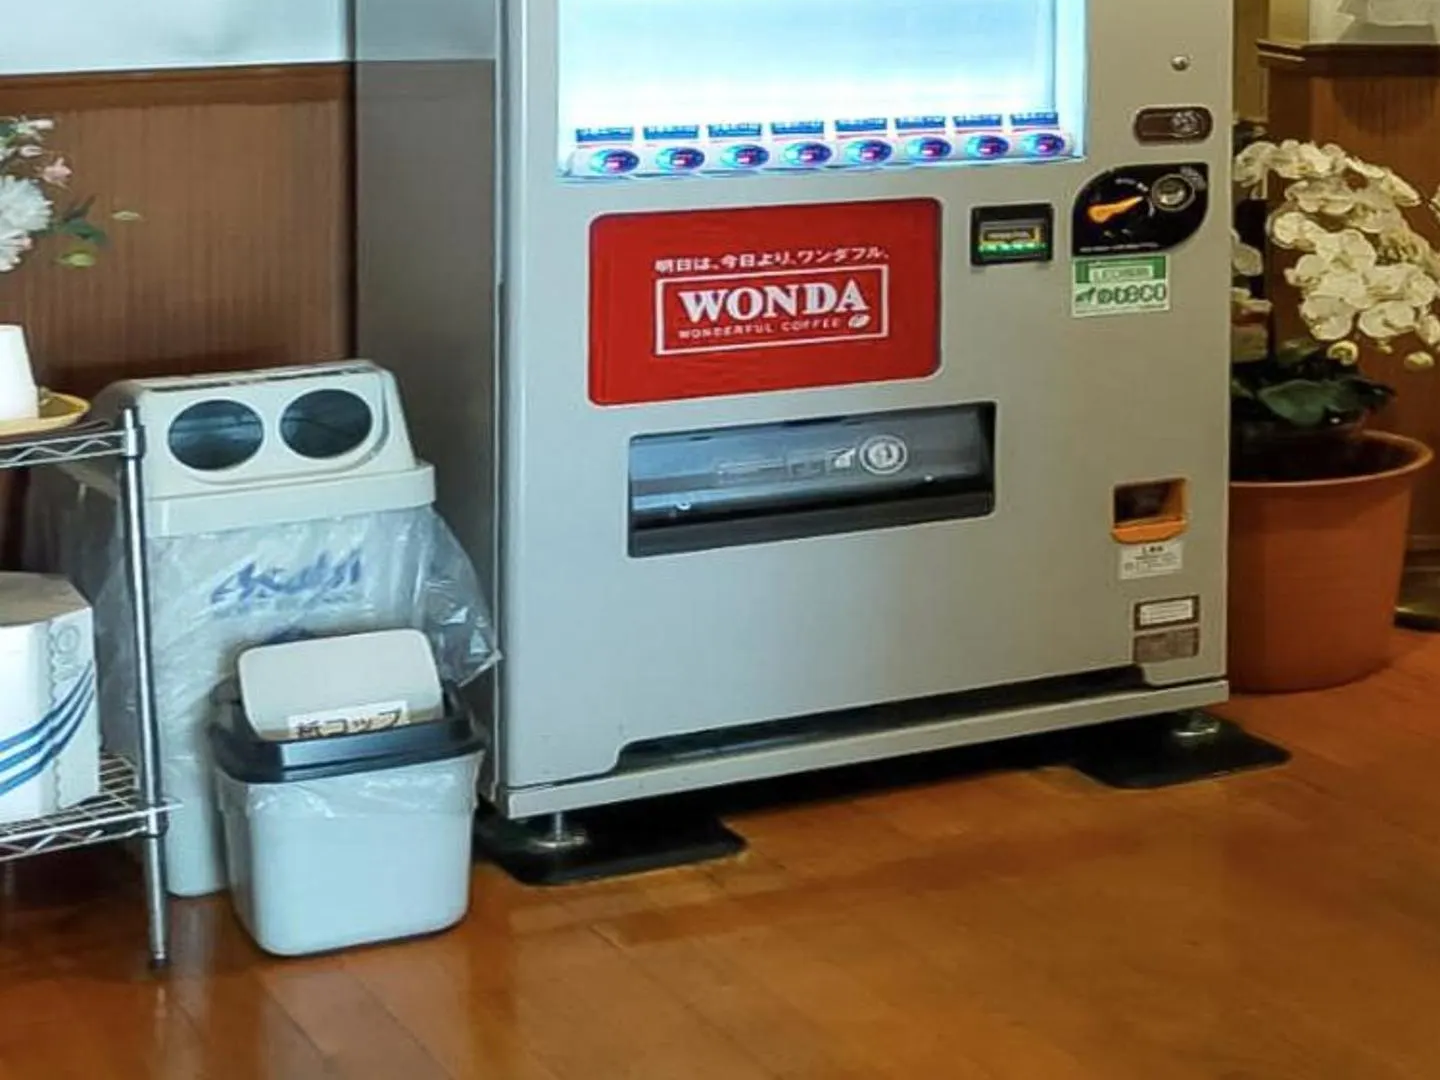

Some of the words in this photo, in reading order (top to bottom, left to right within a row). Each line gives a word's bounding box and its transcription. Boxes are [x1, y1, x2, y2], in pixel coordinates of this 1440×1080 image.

[677, 279, 870, 324] WONDA
[678, 323, 774, 340] WONDERFUL
[781, 320, 839, 332] COFFEE
